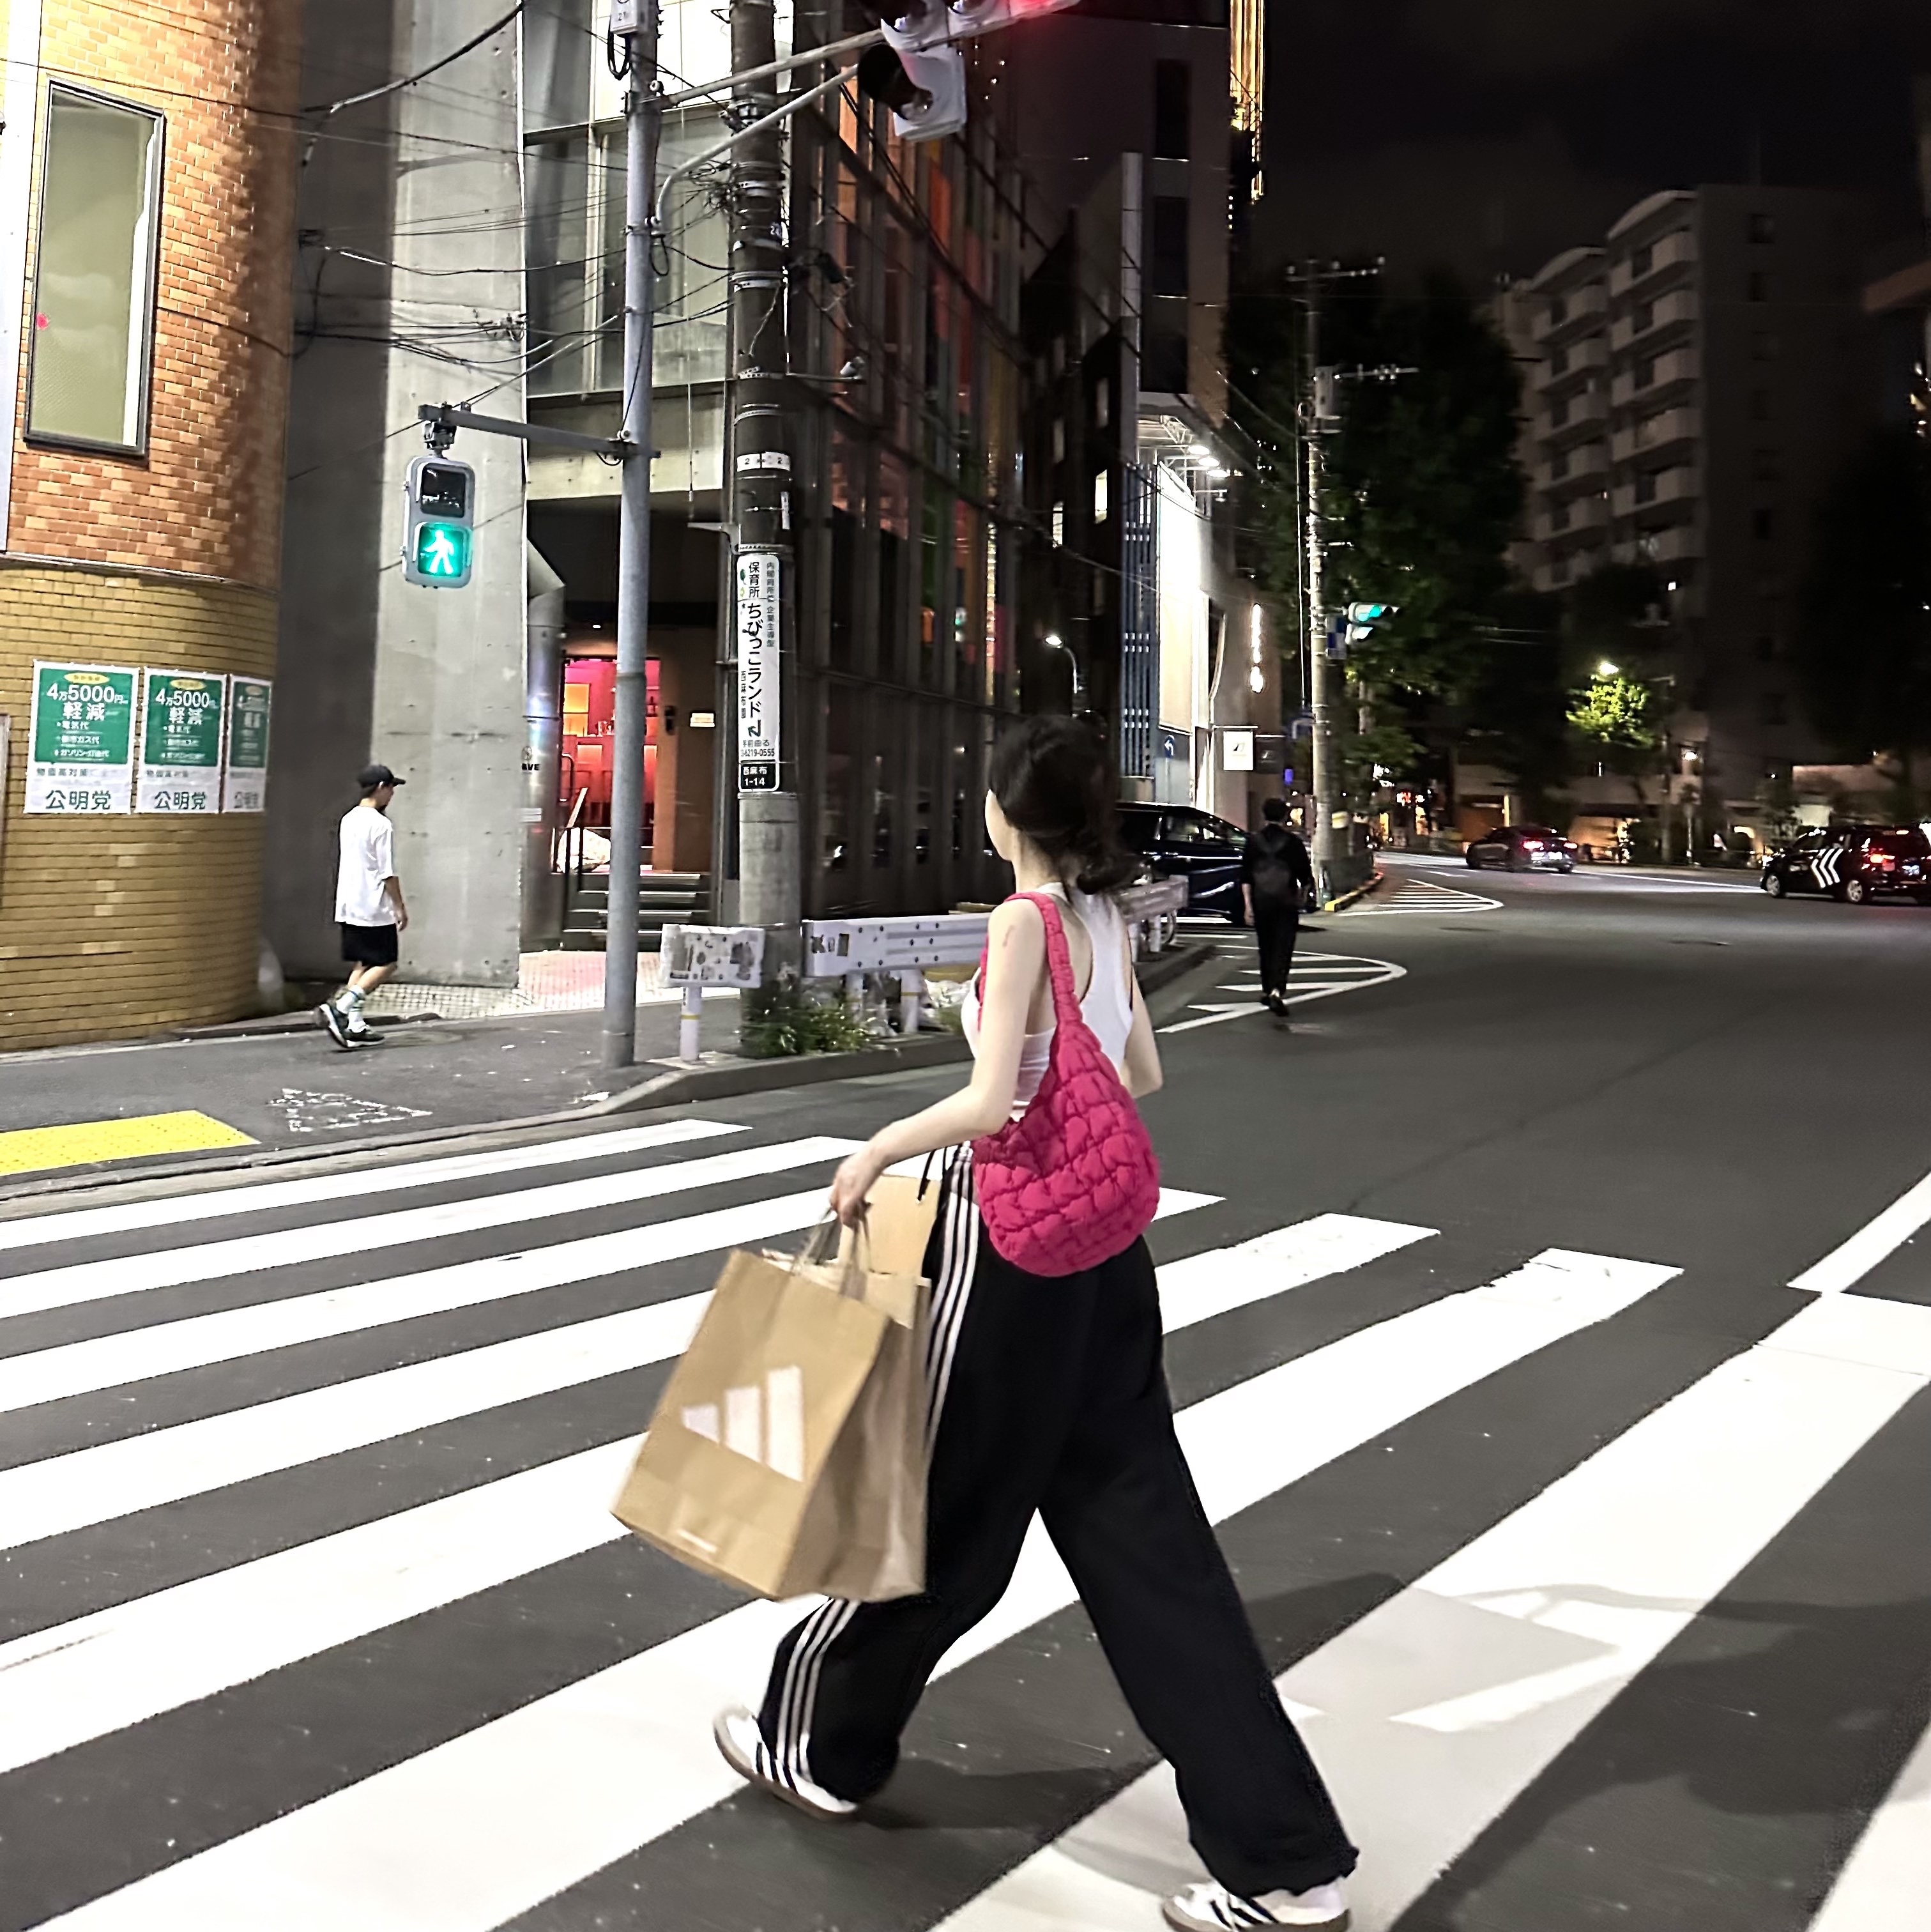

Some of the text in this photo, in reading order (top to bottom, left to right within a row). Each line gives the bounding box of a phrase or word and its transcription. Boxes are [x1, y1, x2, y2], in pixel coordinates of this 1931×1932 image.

[747, 562, 764, 718] 保育所 ちびっこランド
[63, 702, 105, 721] 軽減
[743, 766, 768, 775] 西麻布
[744, 777, 765, 786] 1-14
[45, 790, 111, 810] 公明党
[155, 791, 206, 810] 公明党
